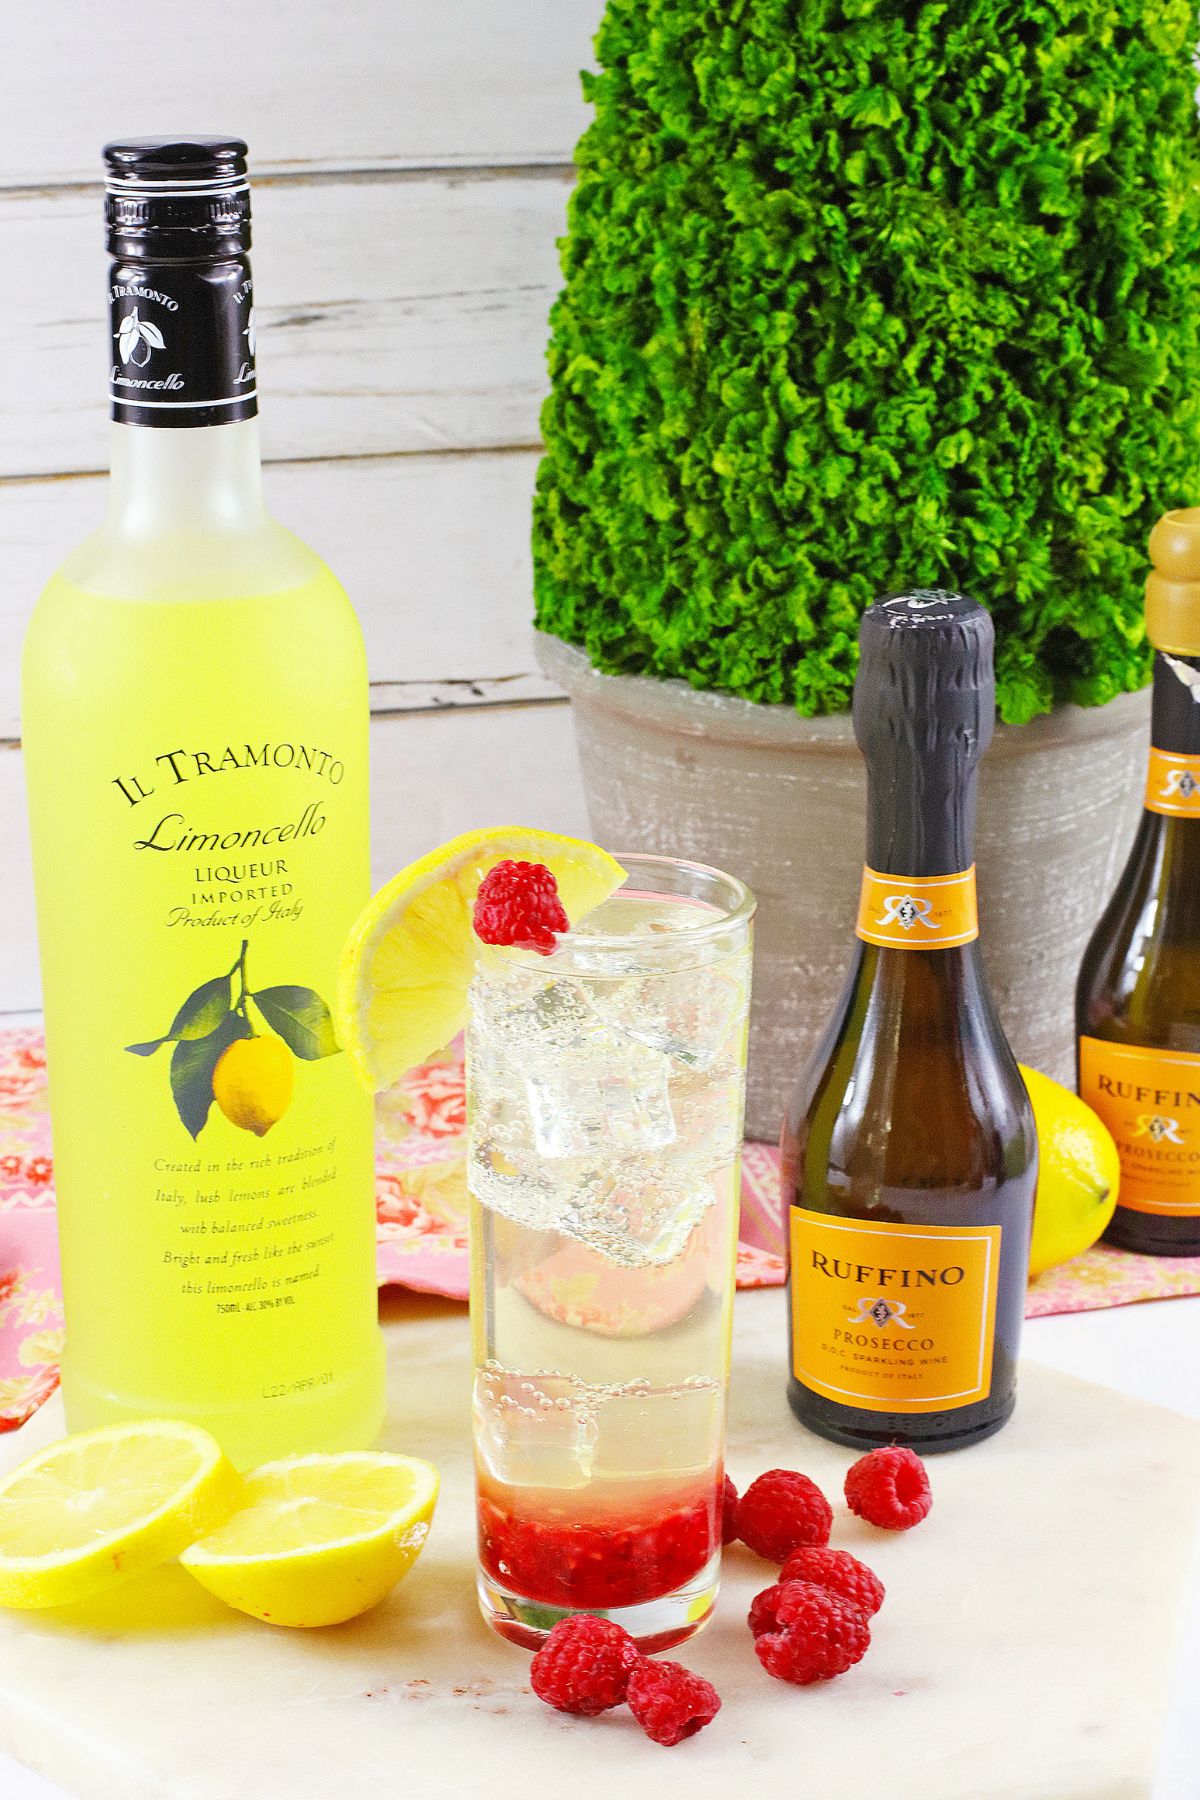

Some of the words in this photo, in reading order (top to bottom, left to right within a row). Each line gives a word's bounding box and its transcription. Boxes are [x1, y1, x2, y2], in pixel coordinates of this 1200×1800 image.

[112, 285, 179, 311] TRAMONTO
[109, 366, 185, 390] Limoncello
[112, 776, 155, 807] IL
[155, 743, 345, 785] TRAMONTO
[133, 800, 326, 852] Limoncello
[195, 859, 288, 883] LIQUEUR
[192, 883, 293, 904] IMPORTED
[166, 905, 238, 928] Product
[240, 905, 264, 928] of
[262, 898, 304, 922] Italy
[153, 1158, 201, 1172] Created
[207, 1159, 220, 1172] in
[226, 1157, 243, 1171] the
[250, 1153, 272, 1170] rich
[277, 1146, 323, 1165] tradition
[154, 1189, 187, 1207] Italy,
[195, 1190, 220, 1203] lush
[229, 1188, 270, 1202] lemons
[278, 1184, 295, 1195] are
[302, 1166, 336, 1190] blended
[180, 1221, 207, 1234] with
[211, 1216, 263, 1234] balanced
[163, 1251, 199, 1268] Bright
[205, 1251, 227, 1264] and
[229, 1247, 259, 1267] fresh
[264, 1245, 283, 1259] like
[287, 1241, 301, 1255] the
[306, 1232, 334, 1250] sunset
[811, 1250, 965, 1288] RUFFINO
[182, 1280, 202, 1294] this
[207, 1277, 267, 1294] limoncello
[833, 1328, 935, 1352] PROSECCO
[840, 1365, 879, 1378] PRODUCT
[853, 1353, 914, 1366] SPARKLING
[920, 1356, 949, 1365] WINE
[262, 1370, 334, 1399] L22/APR/01
